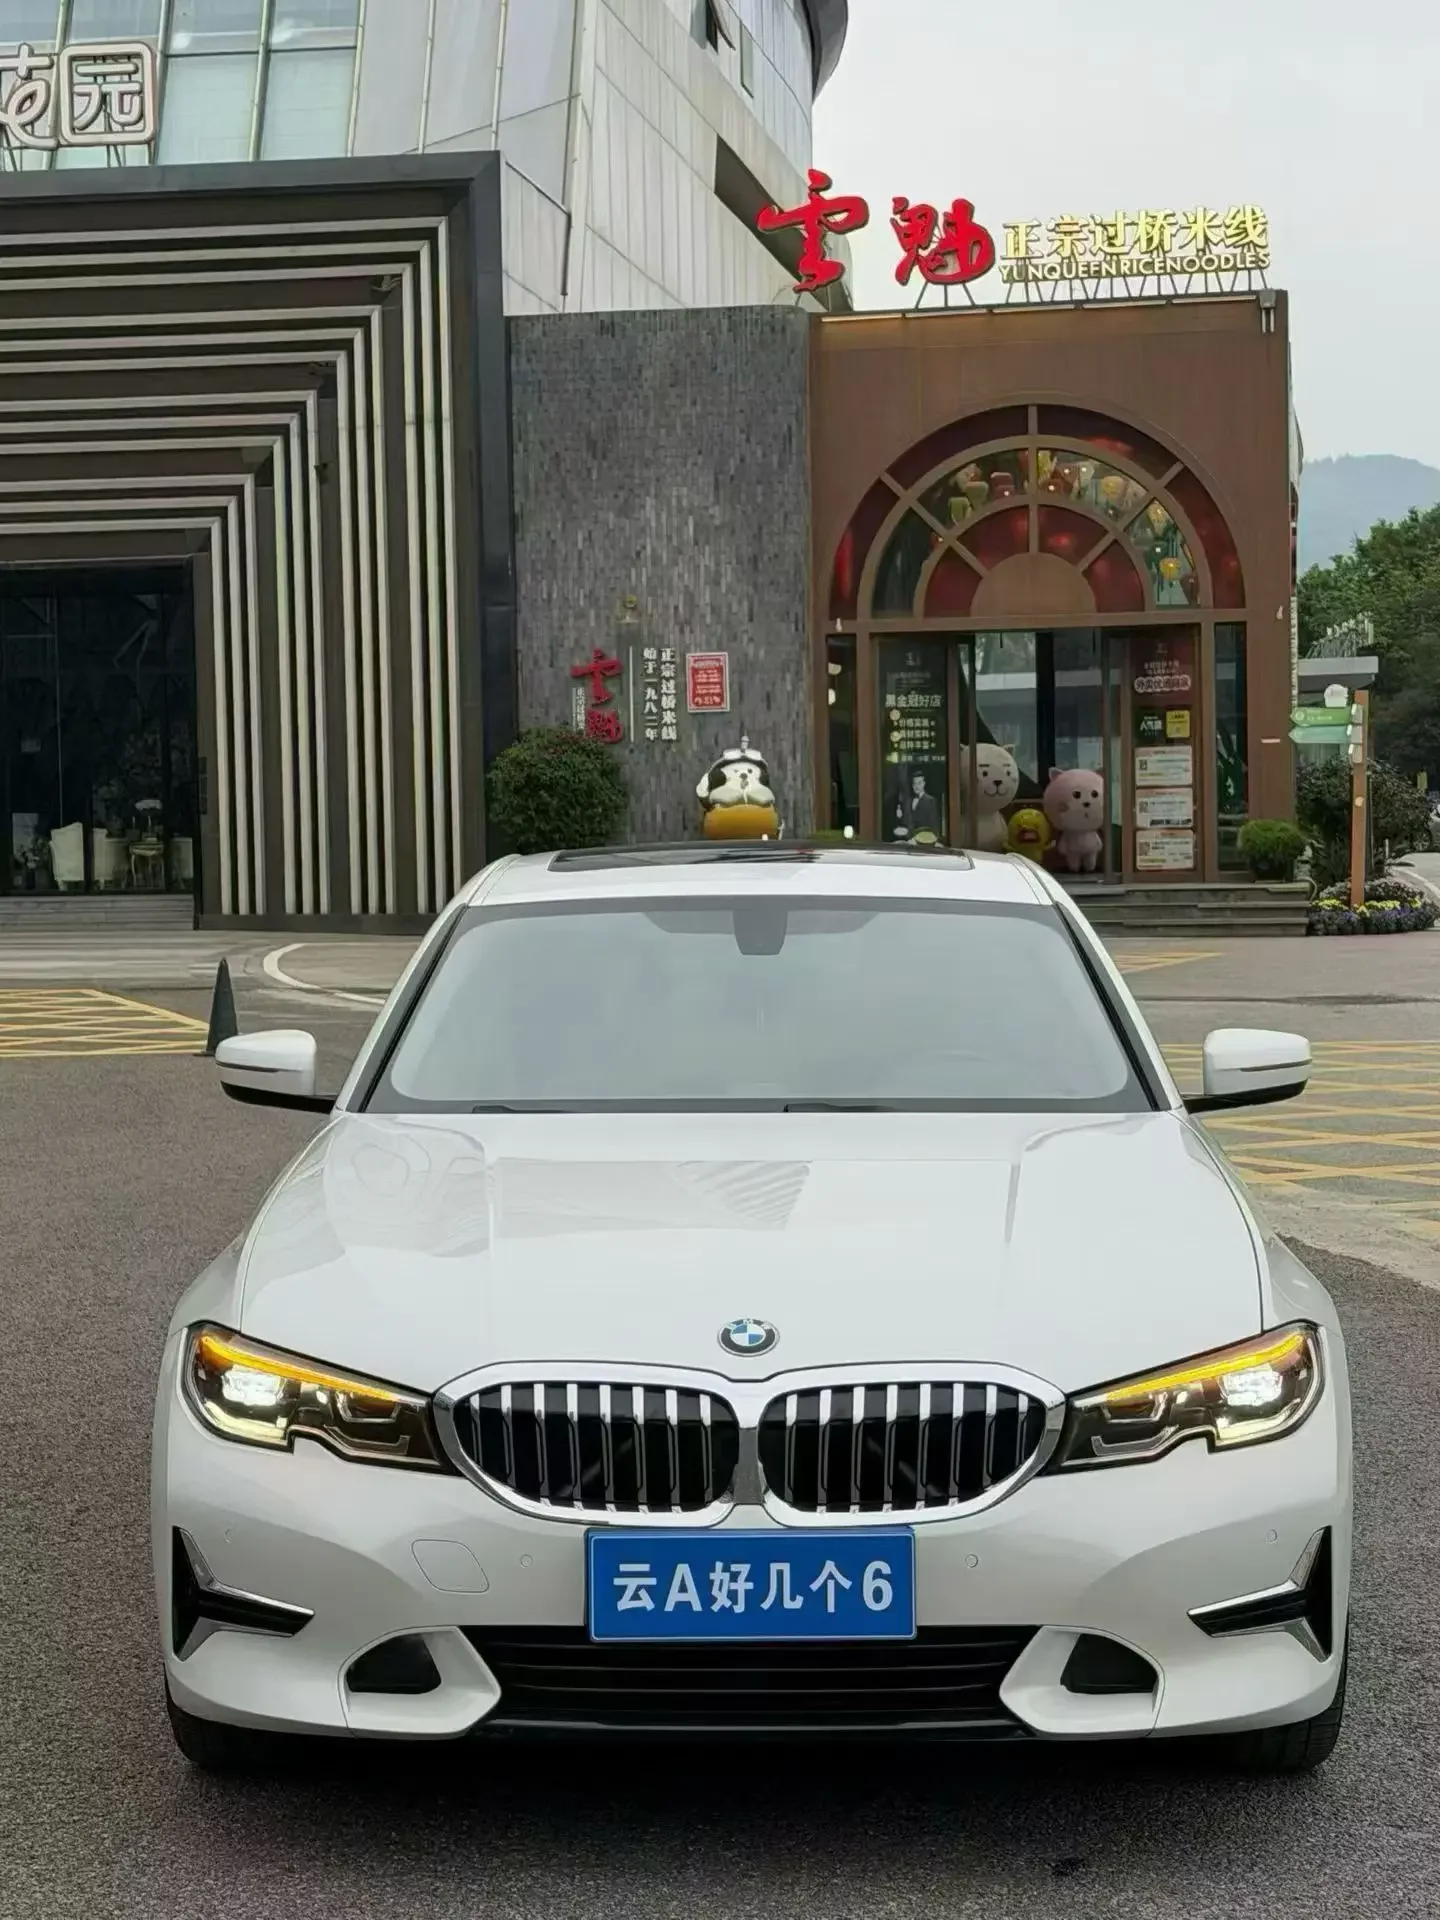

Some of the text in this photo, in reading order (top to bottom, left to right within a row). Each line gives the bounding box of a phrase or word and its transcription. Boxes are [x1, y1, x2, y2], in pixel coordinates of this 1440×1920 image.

[1001, 204, 1269, 259] 正宗过桥米线
[660, 648, 677, 741] 正宗过桥米线
[613, 1560, 893, 1614] 云A好几个6
